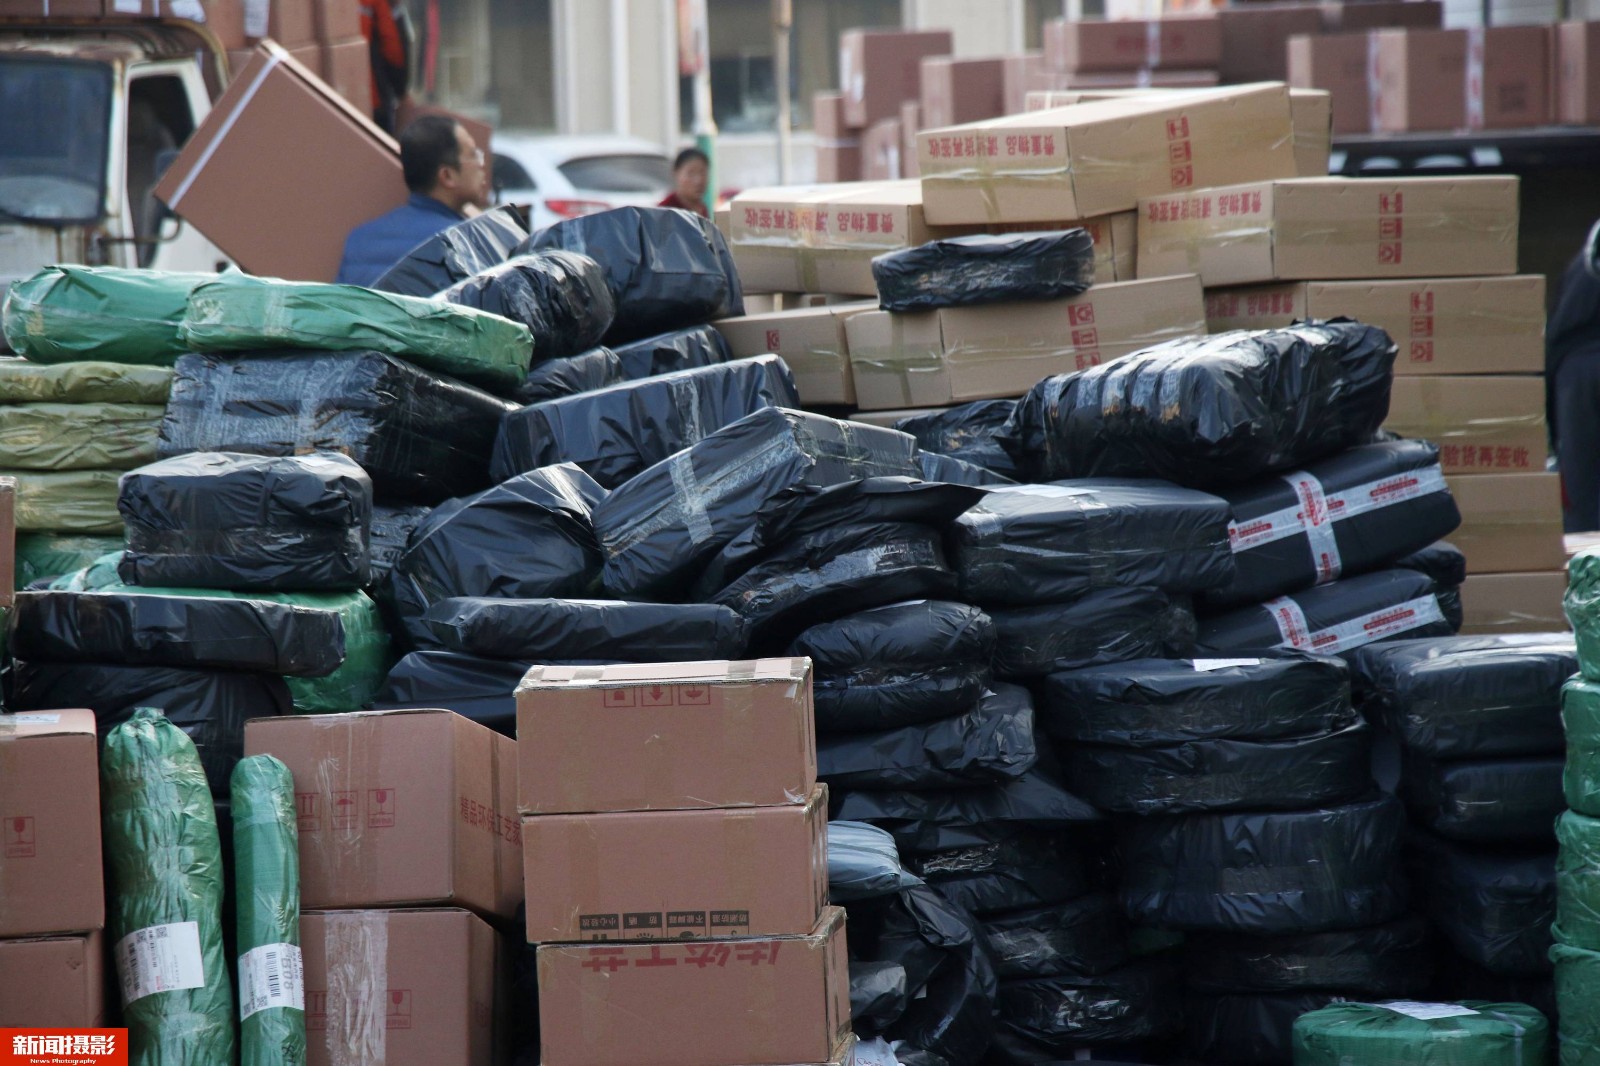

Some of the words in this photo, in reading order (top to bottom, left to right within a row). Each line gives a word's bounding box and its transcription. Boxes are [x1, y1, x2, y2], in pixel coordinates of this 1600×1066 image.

[928, 135, 999, 159] 请验货再签收
[1006, 135, 1055, 157] 贵重物品
[1148, 195, 1212, 223] 请验货再签收
[1218, 190, 1262, 216] 贵重物品
[837, 207, 894, 233] 贵重物品
[1247, 292, 1294, 316] 贵重物品
[1443, 444, 1530, 468] 验货再签收
[581, 918, 617, 927] 小心轻放
